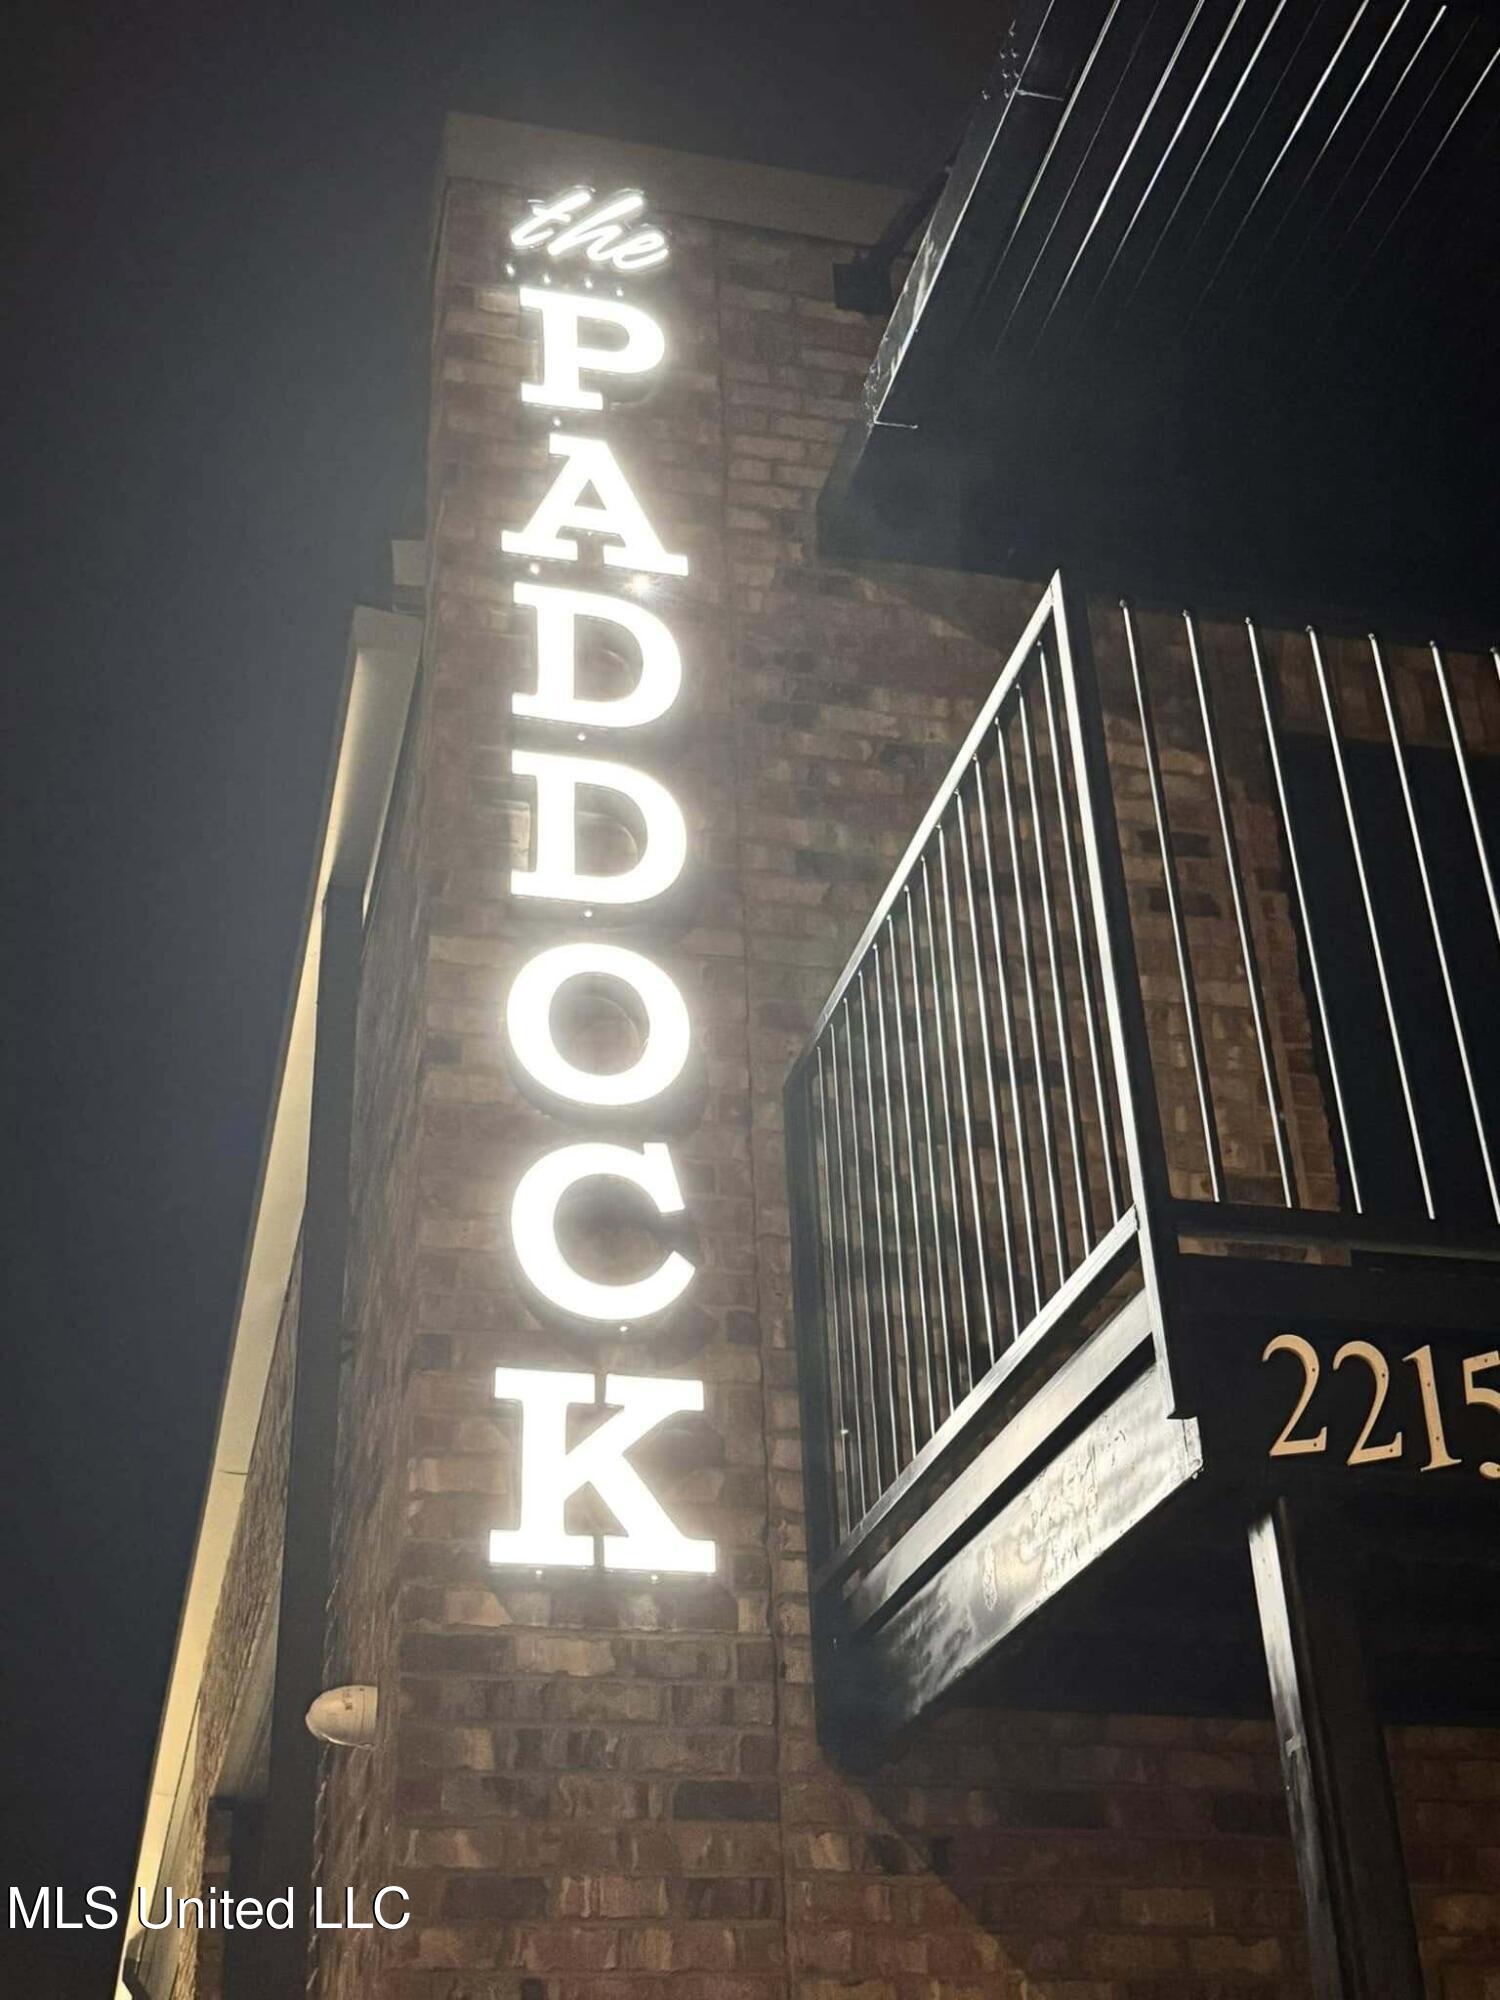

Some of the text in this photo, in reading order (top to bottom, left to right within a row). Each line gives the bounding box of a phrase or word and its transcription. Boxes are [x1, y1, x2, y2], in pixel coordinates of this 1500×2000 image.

[510, 188, 669, 270] the
[488, 287, 717, 1574] PADDOCK
[1262, 1333, 1500, 1479] 2215
